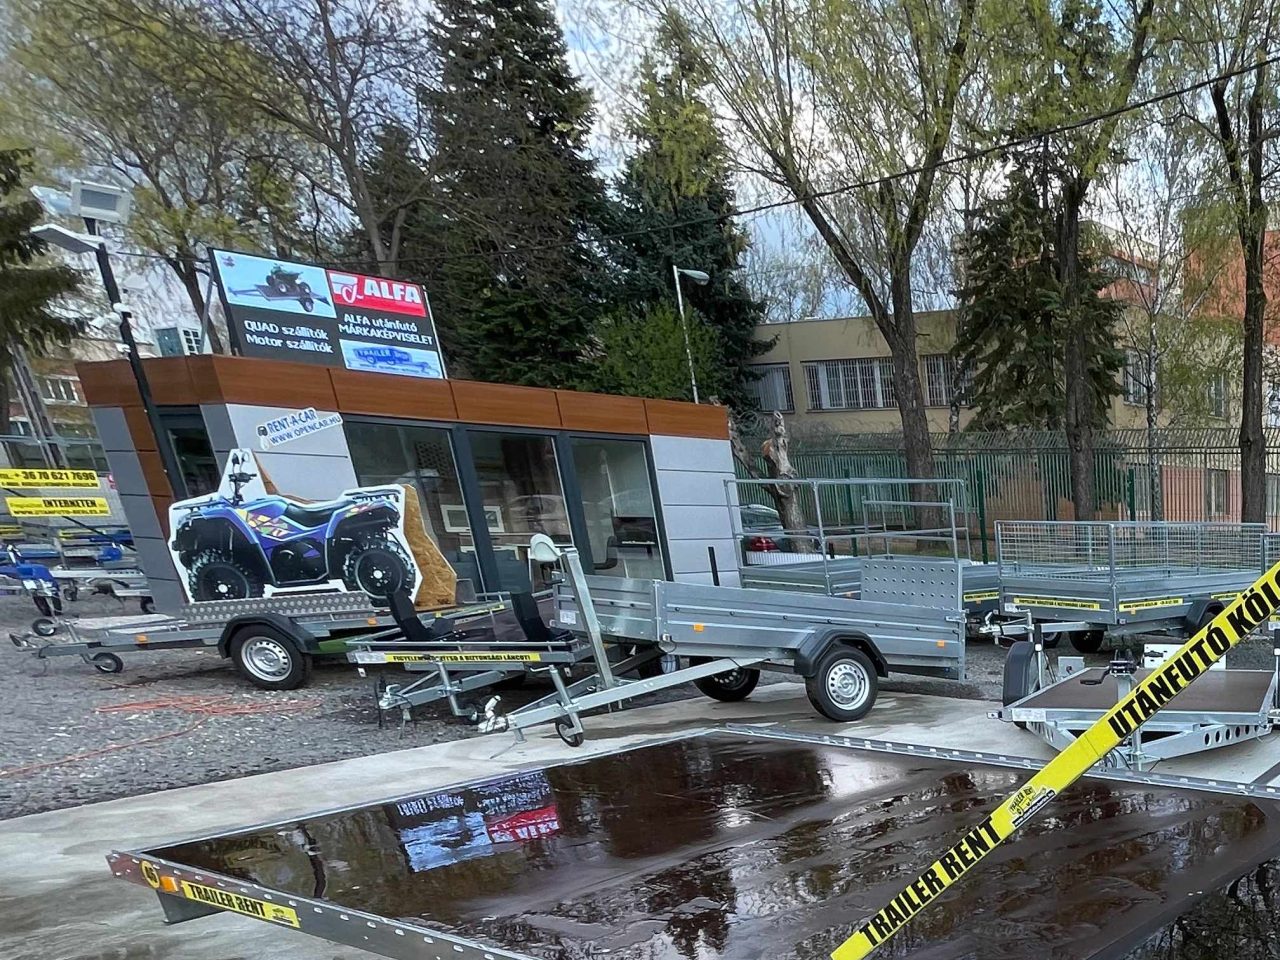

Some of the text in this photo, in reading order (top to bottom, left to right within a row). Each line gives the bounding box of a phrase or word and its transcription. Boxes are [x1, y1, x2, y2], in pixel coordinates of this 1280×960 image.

[363, 278, 422, 304] ALFA
[243, 320, 329, 341] QUAD szállítók
[338, 323, 433, 346] MÁRKAKÉPVISELET
[343, 313, 418, 333] ALFA utánfutó
[245, 333, 334, 354] Motor szállítók
[266, 409, 317, 434] RENT-A-CAR
[50, 471, 69, 481] 621
[71, 471, 96, 482] 7696
[42, 499, 97, 508] INTERNETEN
[1108, 619, 1231, 740] UTÁNFUTÓ
[859, 815, 1002, 947] TRAILER RENT
[187, 884, 266, 917] TRAILER RENT
